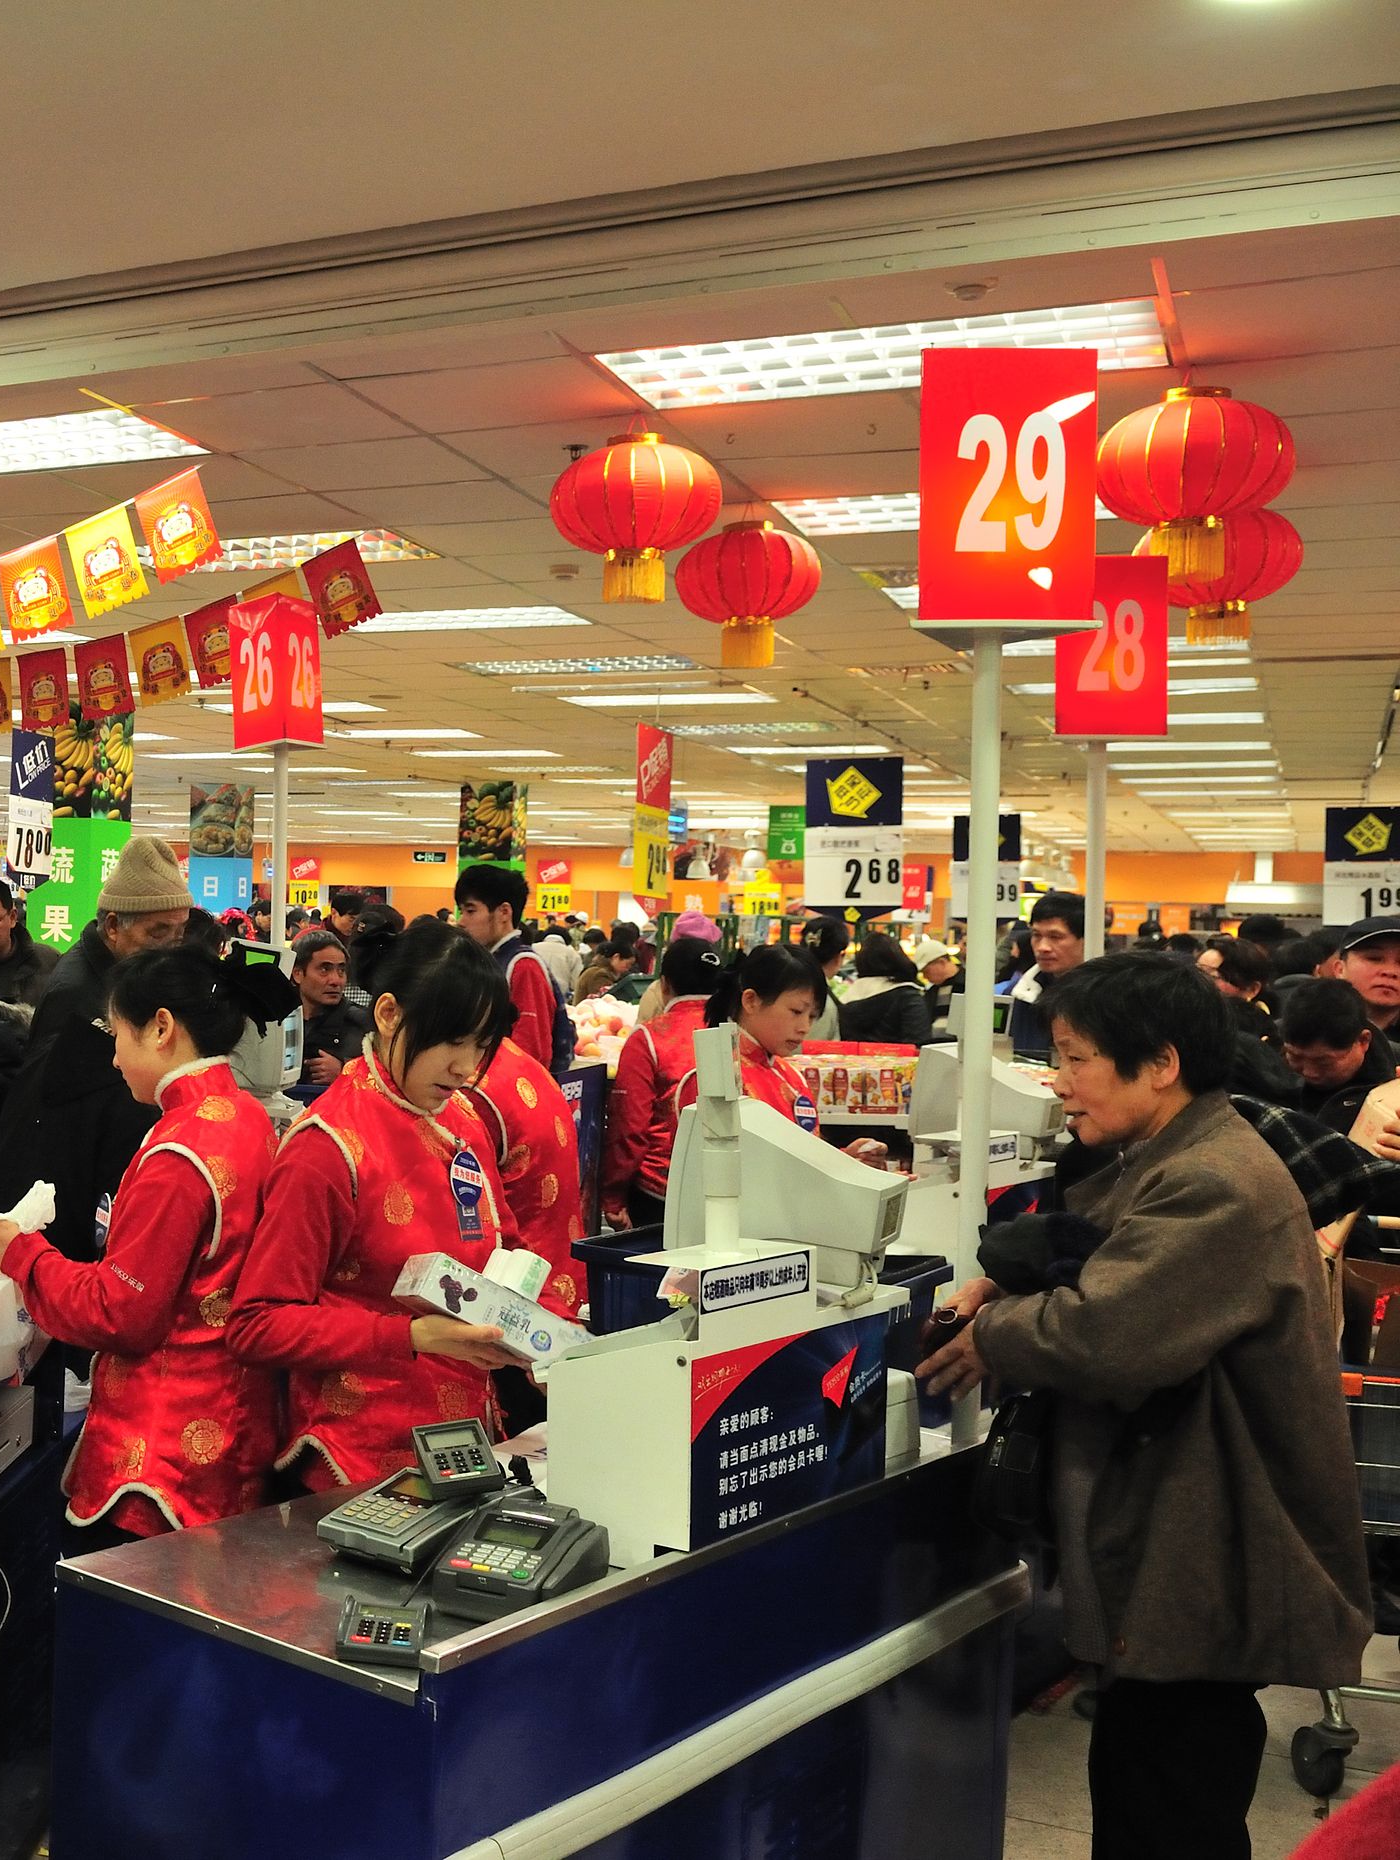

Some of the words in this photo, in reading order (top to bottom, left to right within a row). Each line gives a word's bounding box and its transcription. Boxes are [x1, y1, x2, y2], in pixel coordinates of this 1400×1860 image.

[955, 411, 1067, 553] 29
[240, 631, 273, 714] 26
[288, 632, 316, 710] 26
[1077, 599, 1146, 692] 28
[22, 739, 50, 776] 低价
[40, 846, 75, 943] 蔬果
[718, 1423, 820, 1470] 请当面点清现金及物品。
[719, 1405, 774, 1437] 亲爱的顾客：
[718, 1444, 828, 1496] 别忘了出示您的会员卡喔！
[718, 1500, 763, 1530] 谢谢光临！
